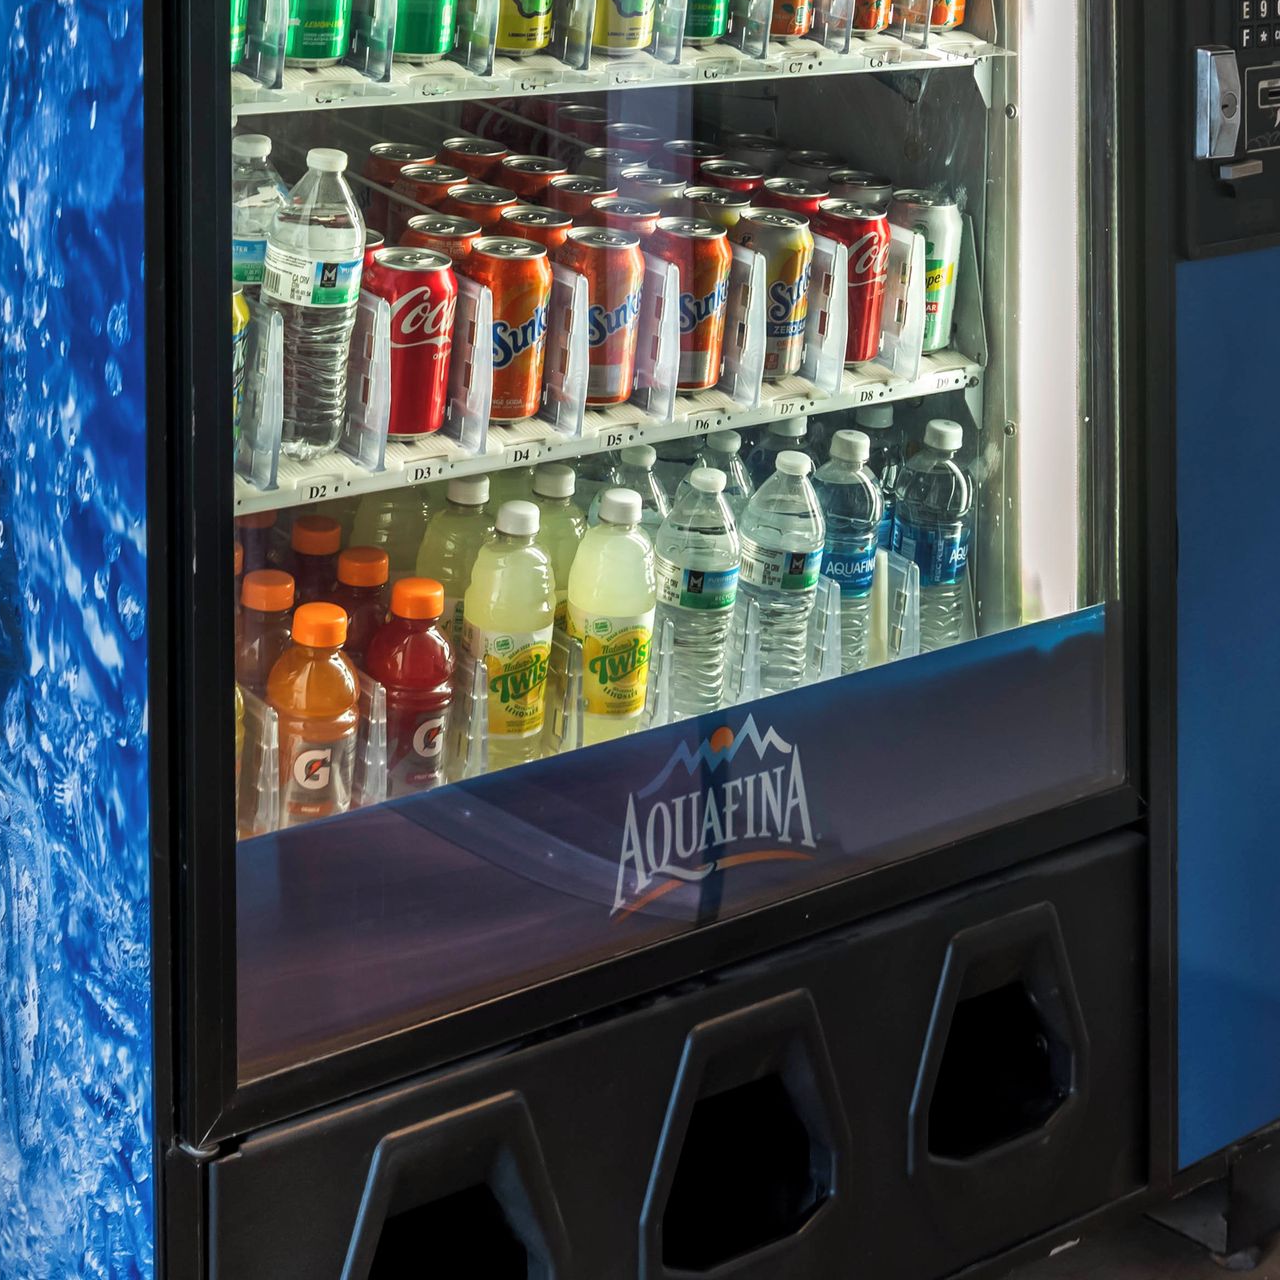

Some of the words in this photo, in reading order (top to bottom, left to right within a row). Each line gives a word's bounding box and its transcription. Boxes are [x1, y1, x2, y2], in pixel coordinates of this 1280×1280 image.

[1243, 1, 1250, 19] E
[1260, 0, 1267, 18] 9
[1243, 29, 1250, 47] F
[789, 62, 804, 73] C7
[936, 377, 950, 389] D9
[860, 390, 874, 402] D8
[780, 403, 794, 414] D7
[606, 433, 623, 446] D5
[513, 448, 530, 462] D4
[414, 466, 431, 480] D3
[309, 484, 327, 499] D2
[413, 719, 444, 758] G
[293, 749, 332, 790] G
[610, 743, 817, 917] AQUAFINA
